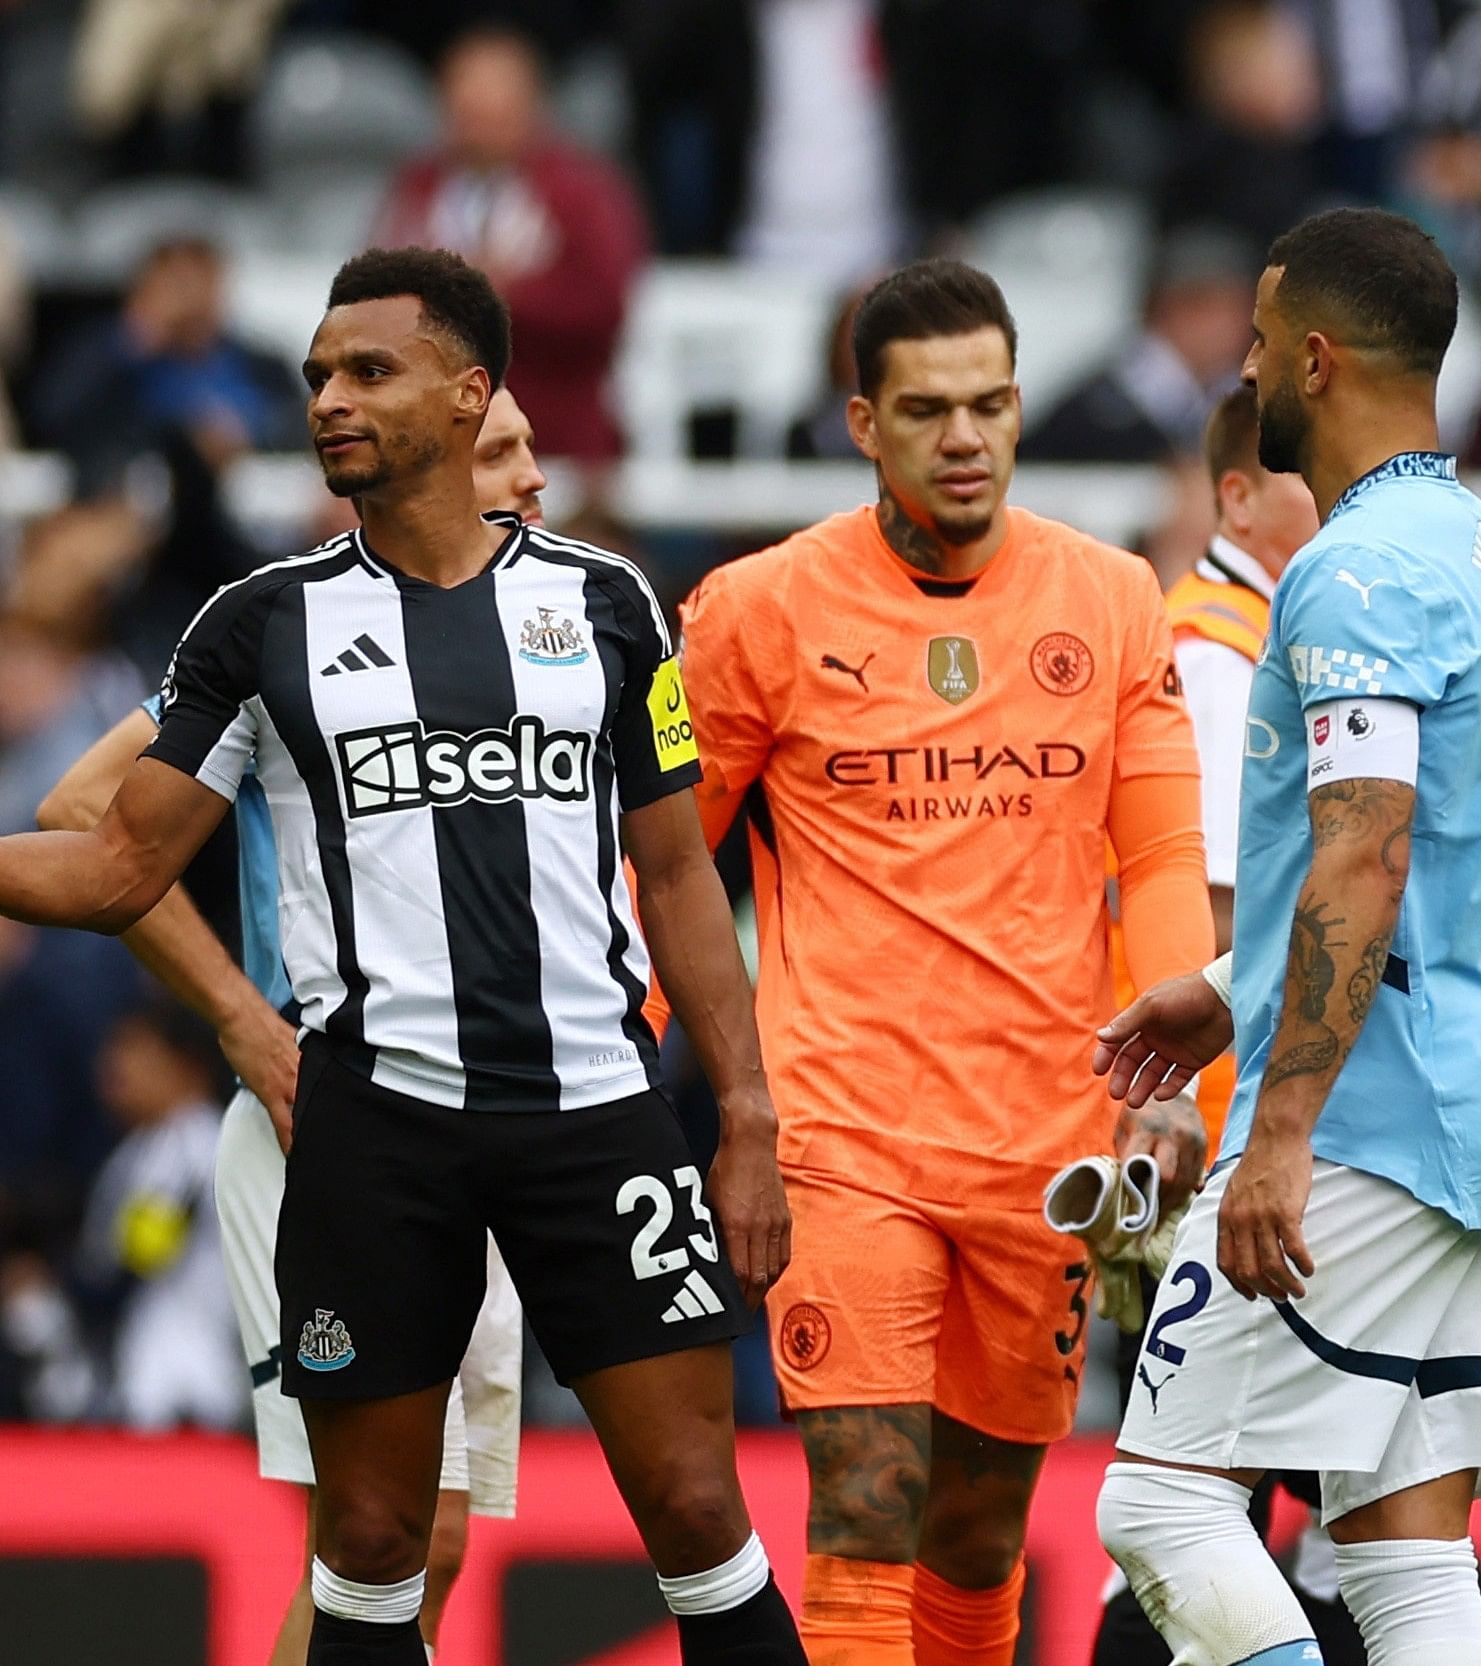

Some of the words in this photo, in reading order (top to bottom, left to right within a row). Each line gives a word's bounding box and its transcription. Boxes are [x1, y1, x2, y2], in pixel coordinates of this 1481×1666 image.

[943, 679, 967, 690] FIFA
[657, 720, 693, 752] noo
[425, 724, 585, 796] sela
[825, 743, 1086, 786] ETIHAD
[886, 793, 1033, 821] AIRWAYS
[615, 1165, 719, 1281] 23
[1146, 1260, 1212, 1367] 2
